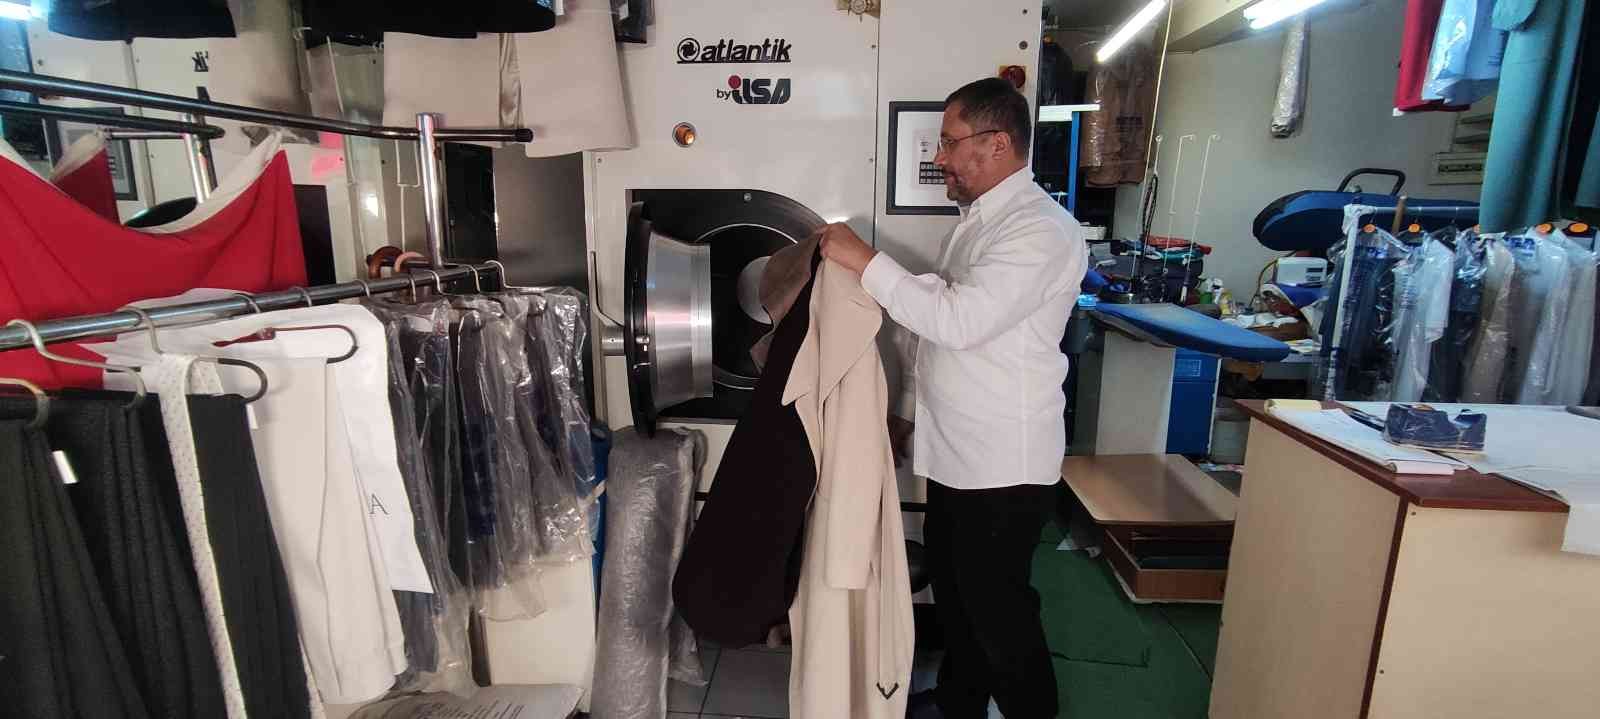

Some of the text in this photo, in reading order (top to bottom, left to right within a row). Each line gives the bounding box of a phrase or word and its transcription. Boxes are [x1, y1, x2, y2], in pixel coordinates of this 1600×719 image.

[701, 38, 792, 61] atlantik
[716, 89, 731, 100] by
[369, 493, 390, 515] A
